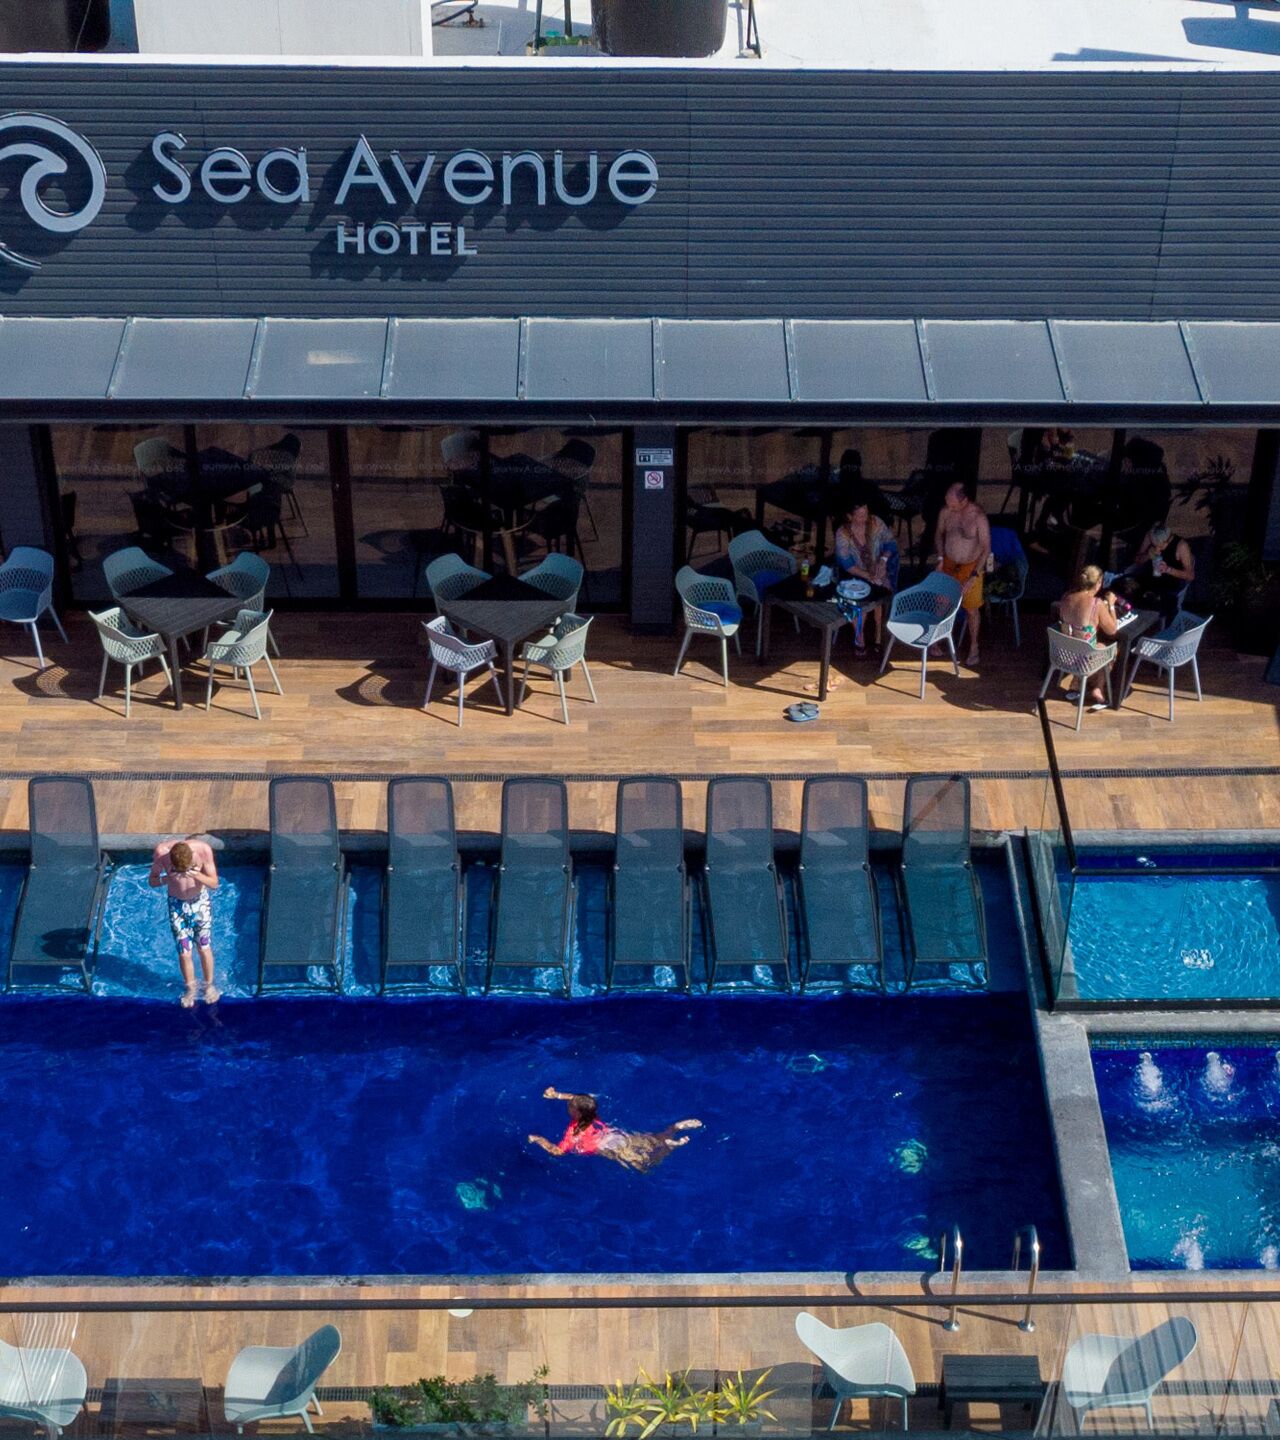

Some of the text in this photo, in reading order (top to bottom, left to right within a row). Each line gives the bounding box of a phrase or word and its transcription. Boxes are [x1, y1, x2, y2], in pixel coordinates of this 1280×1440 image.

[151, 130, 658, 205] Sea Avenue
[337, 221, 477, 255] HOTEL
